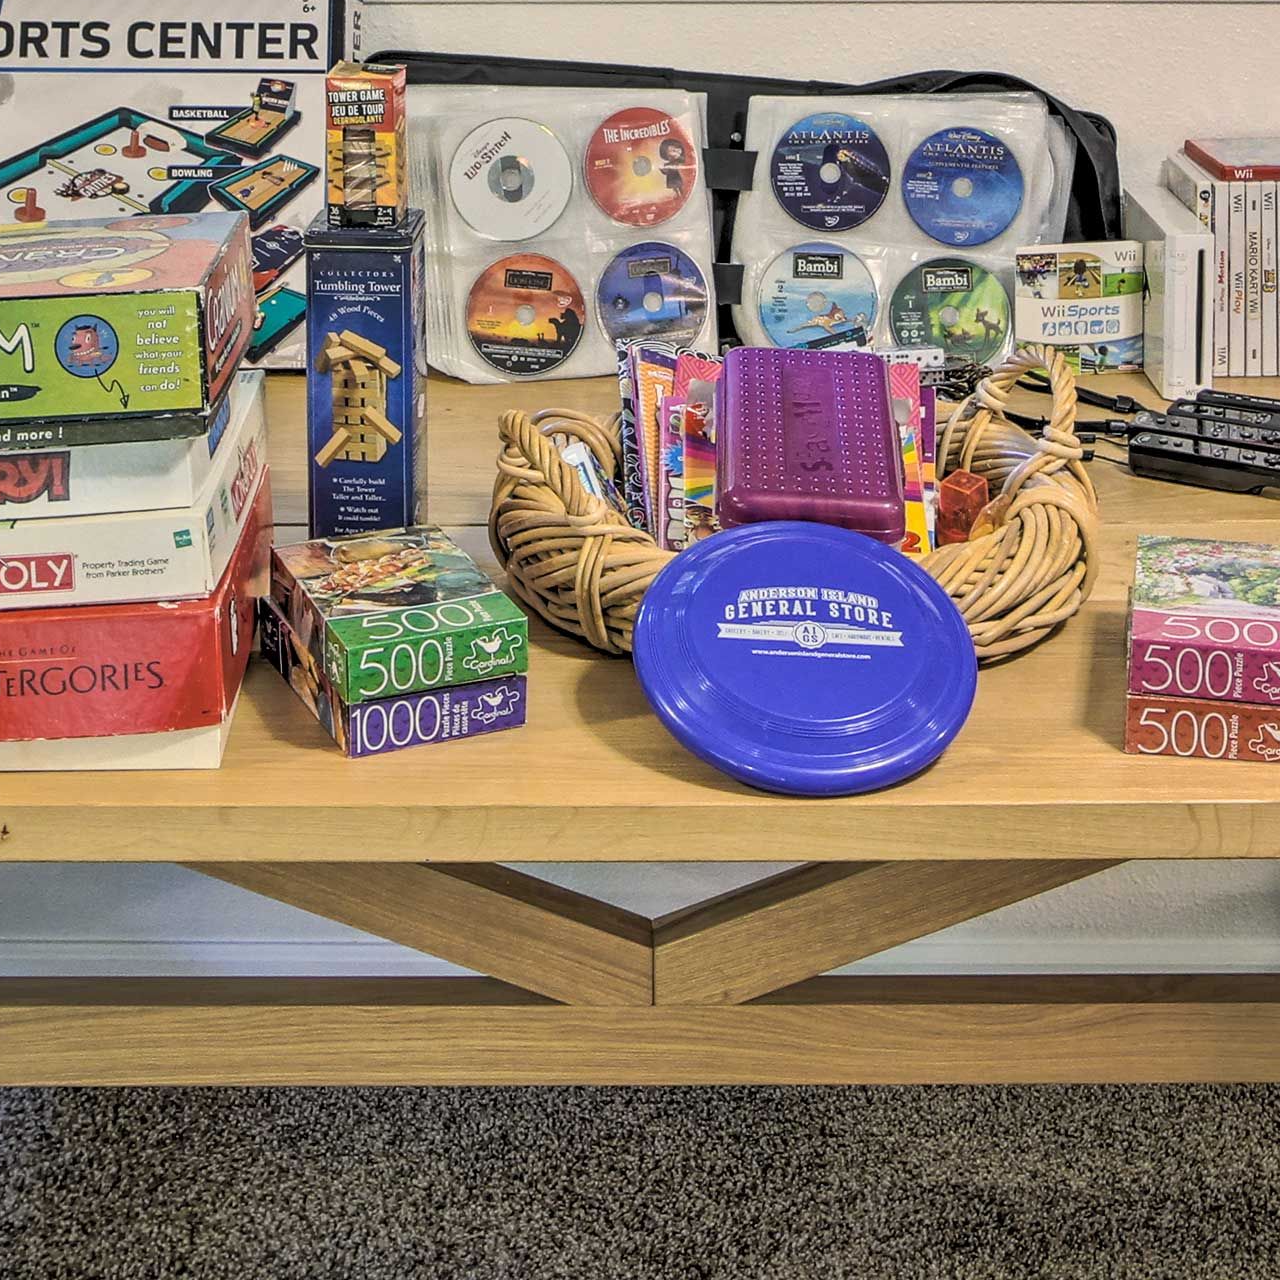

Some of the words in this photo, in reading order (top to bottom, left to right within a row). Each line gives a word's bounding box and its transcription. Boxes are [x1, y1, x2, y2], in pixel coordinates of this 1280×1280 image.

[302, 5, 317, 13] 6+
[127, 22, 319, 60] CENTER
[328, 91, 358, 103] TOWER
[360, 89, 384, 102] GAME
[173, 110, 229, 118] BASKETBALL
[332, 105, 346, 117] JEU
[348, 104, 359, 116] DE
[362, 103, 384, 115] TOUR
[603, 128, 619, 144] THE
[620, 120, 671, 142] INCREDIBLES
[789, 130, 869, 140] ATLANTIS
[923, 143, 1005, 156] ATLANTIS
[172, 169, 213, 177] BOWLING
[1234, 169, 1253, 179] Wii
[1234, 194, 1242, 213] Wii
[1264, 192, 1273, 211] Wii
[1249, 231, 1258, 266] MARIO
[1115, 250, 1136, 262] Wii
[797, 259, 838, 273] Bambi
[314, 280, 365, 294] Tumbling
[367, 281, 401, 292] Tower
[926, 273, 968, 287] Bambi
[1249, 268, 1258, 295] KART
[1067, 305, 1120, 319] Sports
[147, 320, 168, 329] not
[136, 334, 180, 345] believe
[138, 363, 180, 375] friends
[17, 429, 53, 441] more
[82, 560, 116, 570] Property
[117, 558, 145, 568] Trading
[147, 557, 169, 566] Game
[106, 569, 130, 578] Parker
[738, 587, 818, 603] ANDERSON
[821, 588, 878, 609] ISLAND
[725, 600, 816, 620] GENERAL
[829, 603, 893, 628] STORE
[361, 604, 475, 640] 500
[1162, 616, 1279, 646] 500
[752, 649, 871, 660] www.andersonislandgeneralstore.com
[359, 639, 444, 696] 500
[471, 654, 513, 670] Cardinal
[1142, 645, 1233, 696] 500
[351, 695, 442, 754] 1000
[1138, 708, 1228, 758] 500
